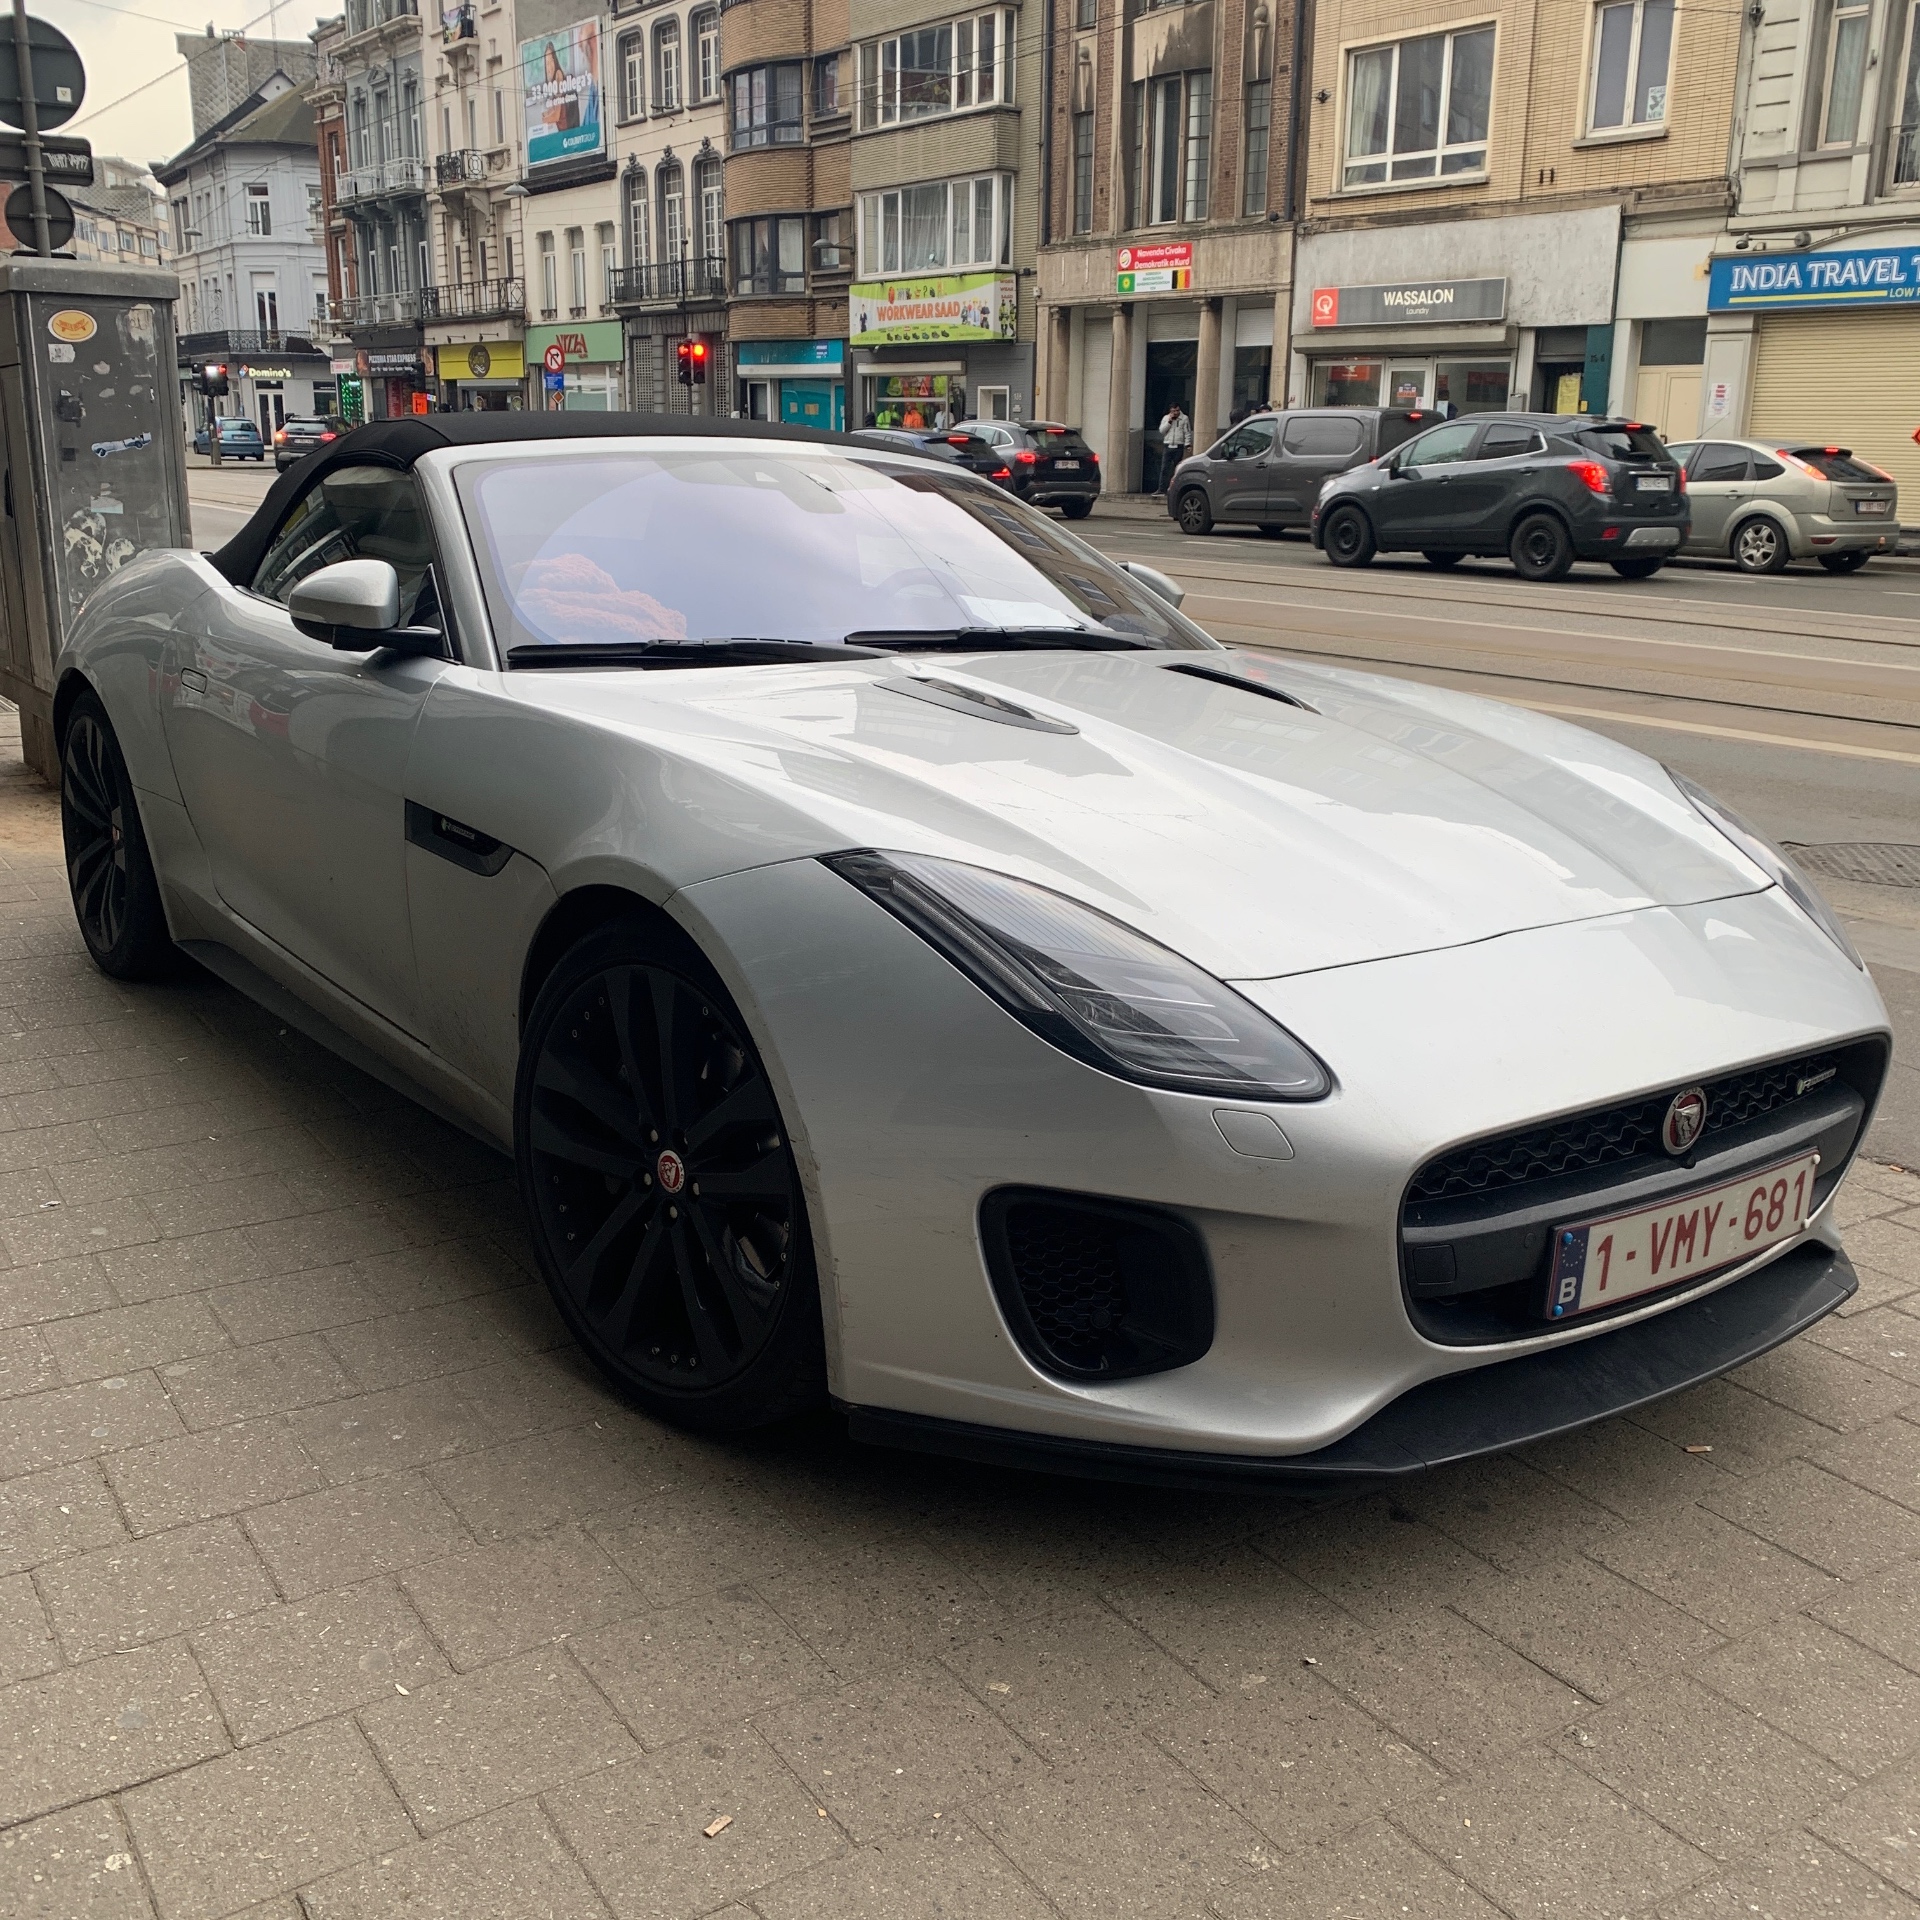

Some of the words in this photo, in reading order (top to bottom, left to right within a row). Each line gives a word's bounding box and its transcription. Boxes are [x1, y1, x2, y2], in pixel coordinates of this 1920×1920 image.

[559, 70, 592, 93] collega's
[1137, 248, 1164, 257] Navenda
[1135, 260, 1169, 268] Demokratik
[1174, 257, 1190, 266] Kurd
[1731, 263, 1802, 291] INDIA
[1807, 257, 1907, 287] TRAVEL
[1383, 288, 1454, 306] WASSALON
[1890, 287, 1914, 298] LOW
[877, 303, 933, 321] WORKWEAR
[935, 301, 961, 318] SAAD
[1405, 306, 1430, 316] Laundry
[387, 354, 397, 363] STAR
[397, 353, 416, 363] EXPRESS
[248, 367, 292, 378] Domino's
[1597, 1170, 1807, 1291] 1-VMY-681
[1557, 1276, 1577, 1304] B
